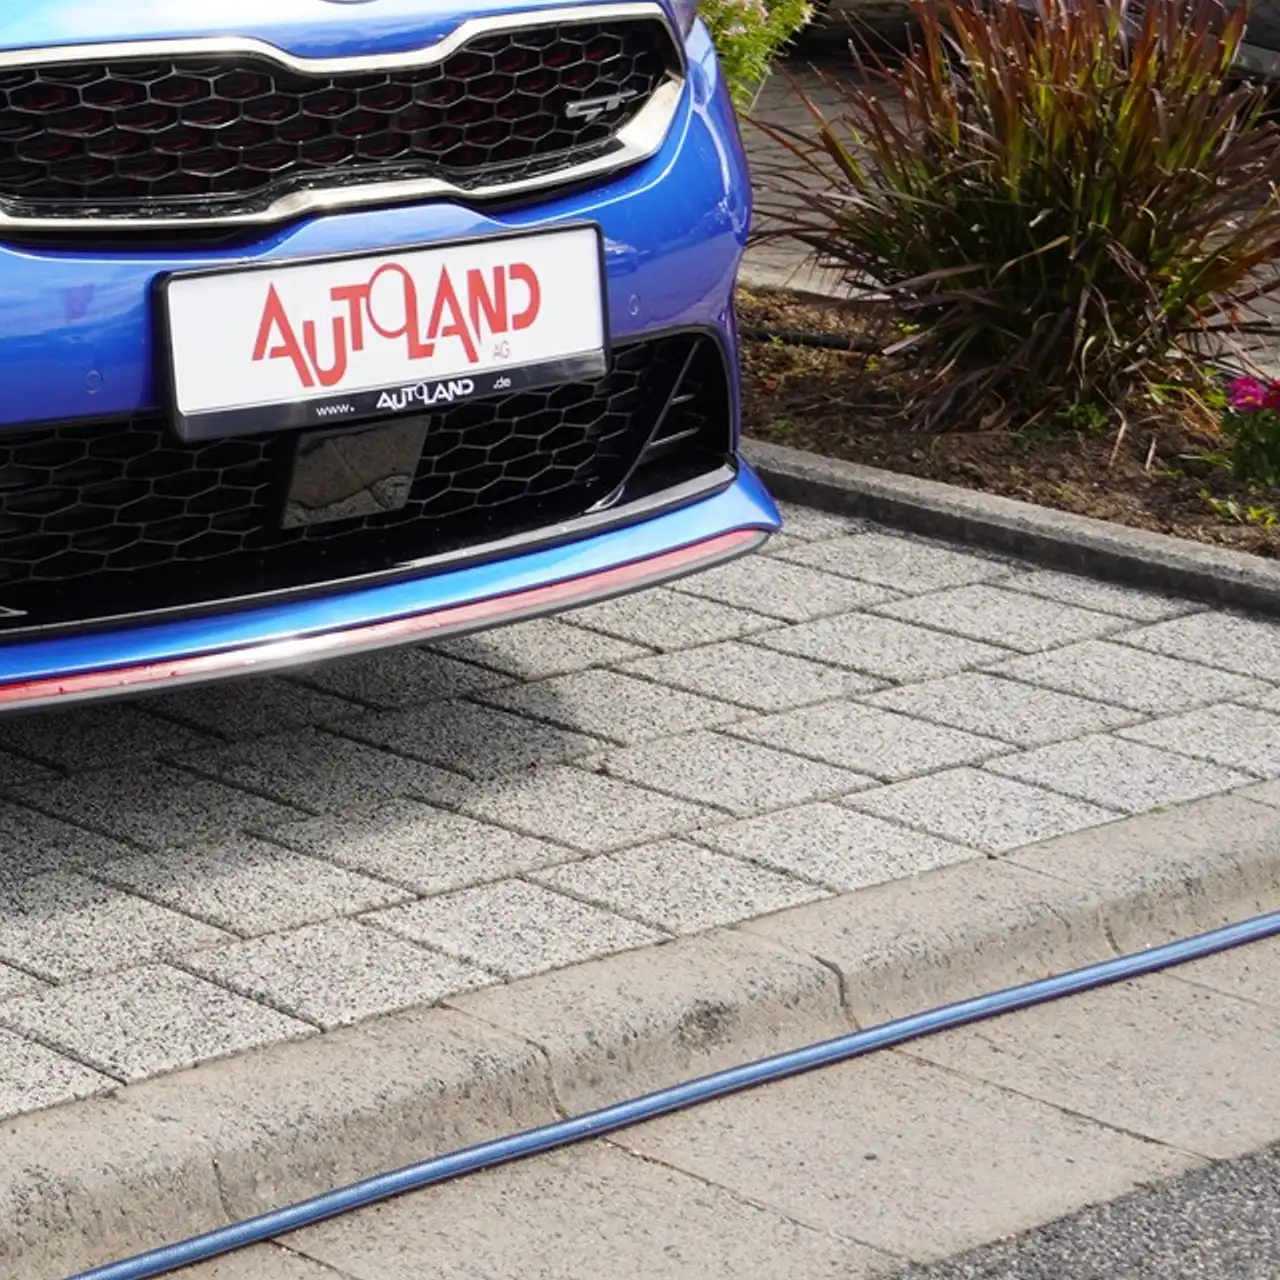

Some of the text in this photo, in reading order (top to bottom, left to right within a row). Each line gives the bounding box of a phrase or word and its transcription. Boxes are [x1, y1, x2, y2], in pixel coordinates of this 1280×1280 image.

[252, 263, 542, 389] AUTOLAND
[493, 340, 511, 361] AG
[316, 376, 512, 417] www. AUTOLAND .de
